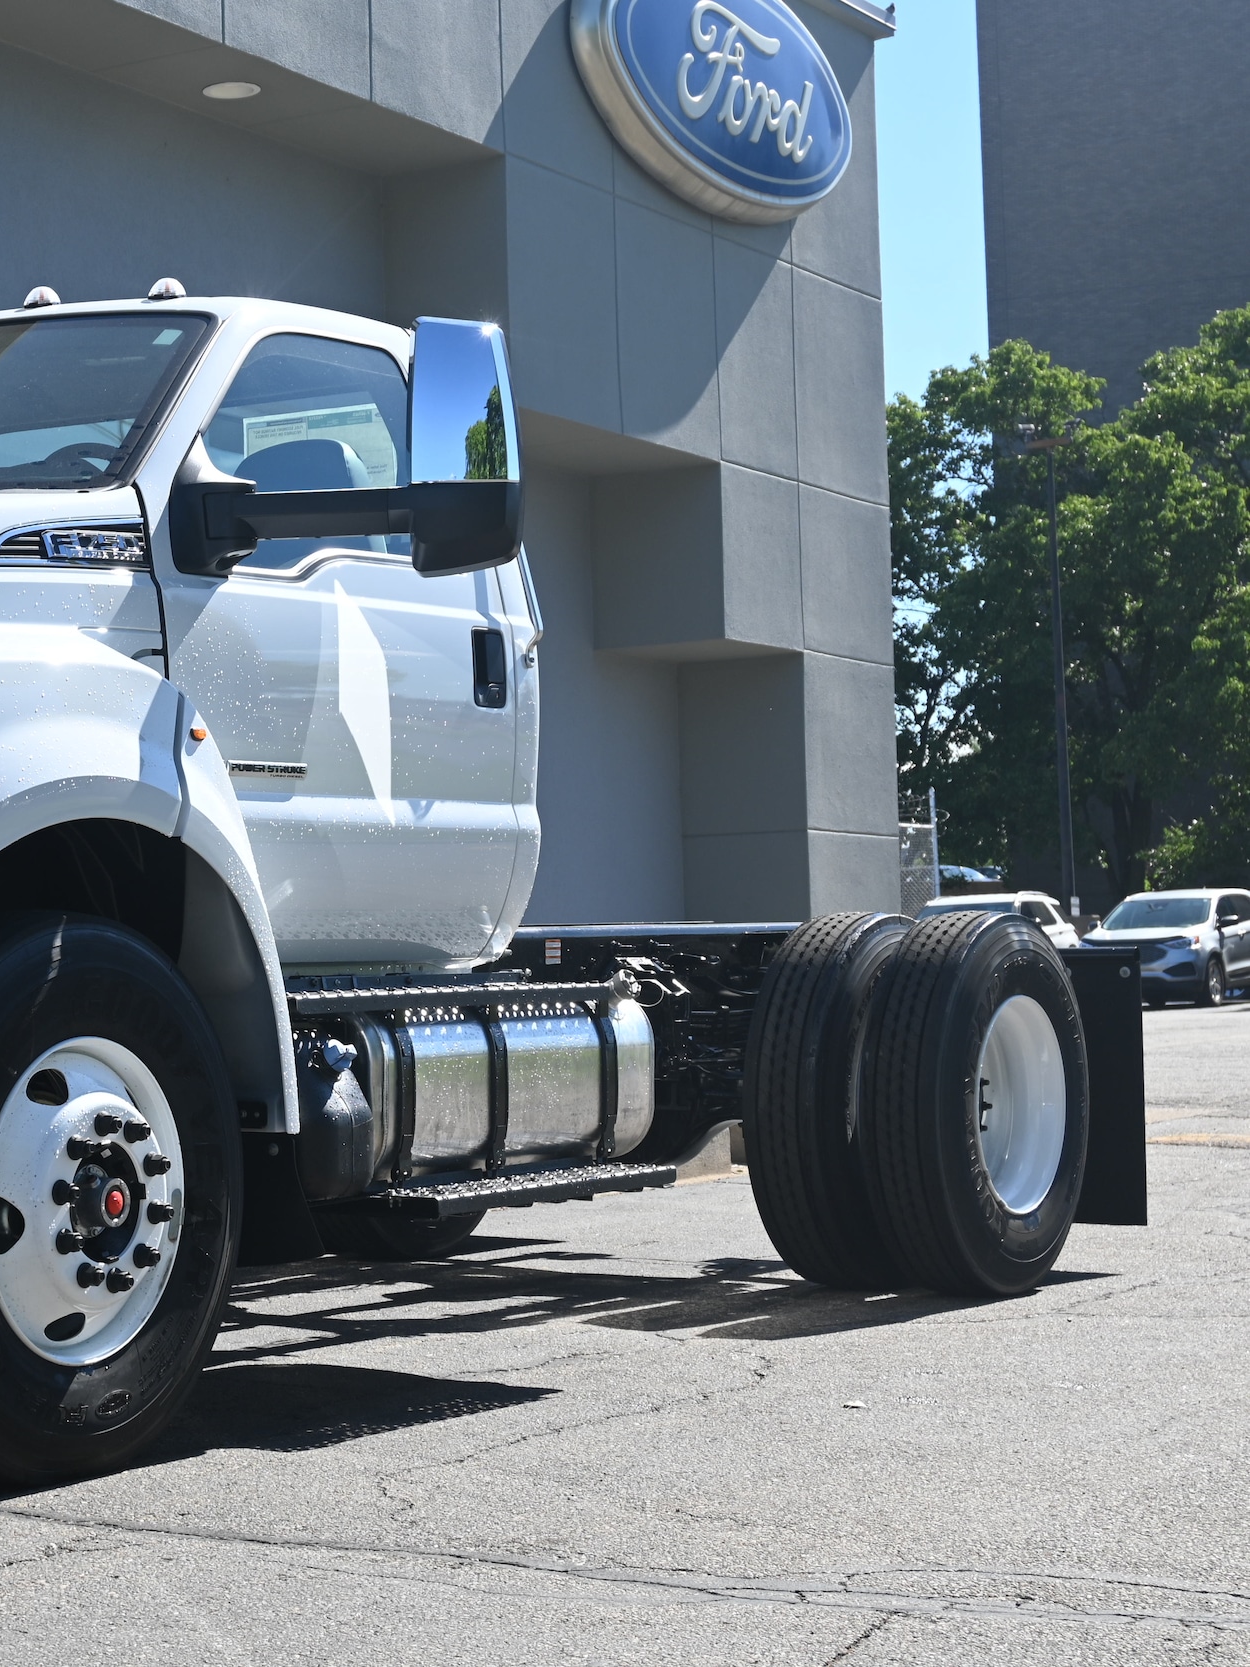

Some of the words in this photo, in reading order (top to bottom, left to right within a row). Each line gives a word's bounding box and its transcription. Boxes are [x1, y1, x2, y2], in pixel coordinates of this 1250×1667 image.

[677, 0, 813, 163] Ford
[231, 763, 265, 773] POWER
[267, 765, 306, 774] STROKE
